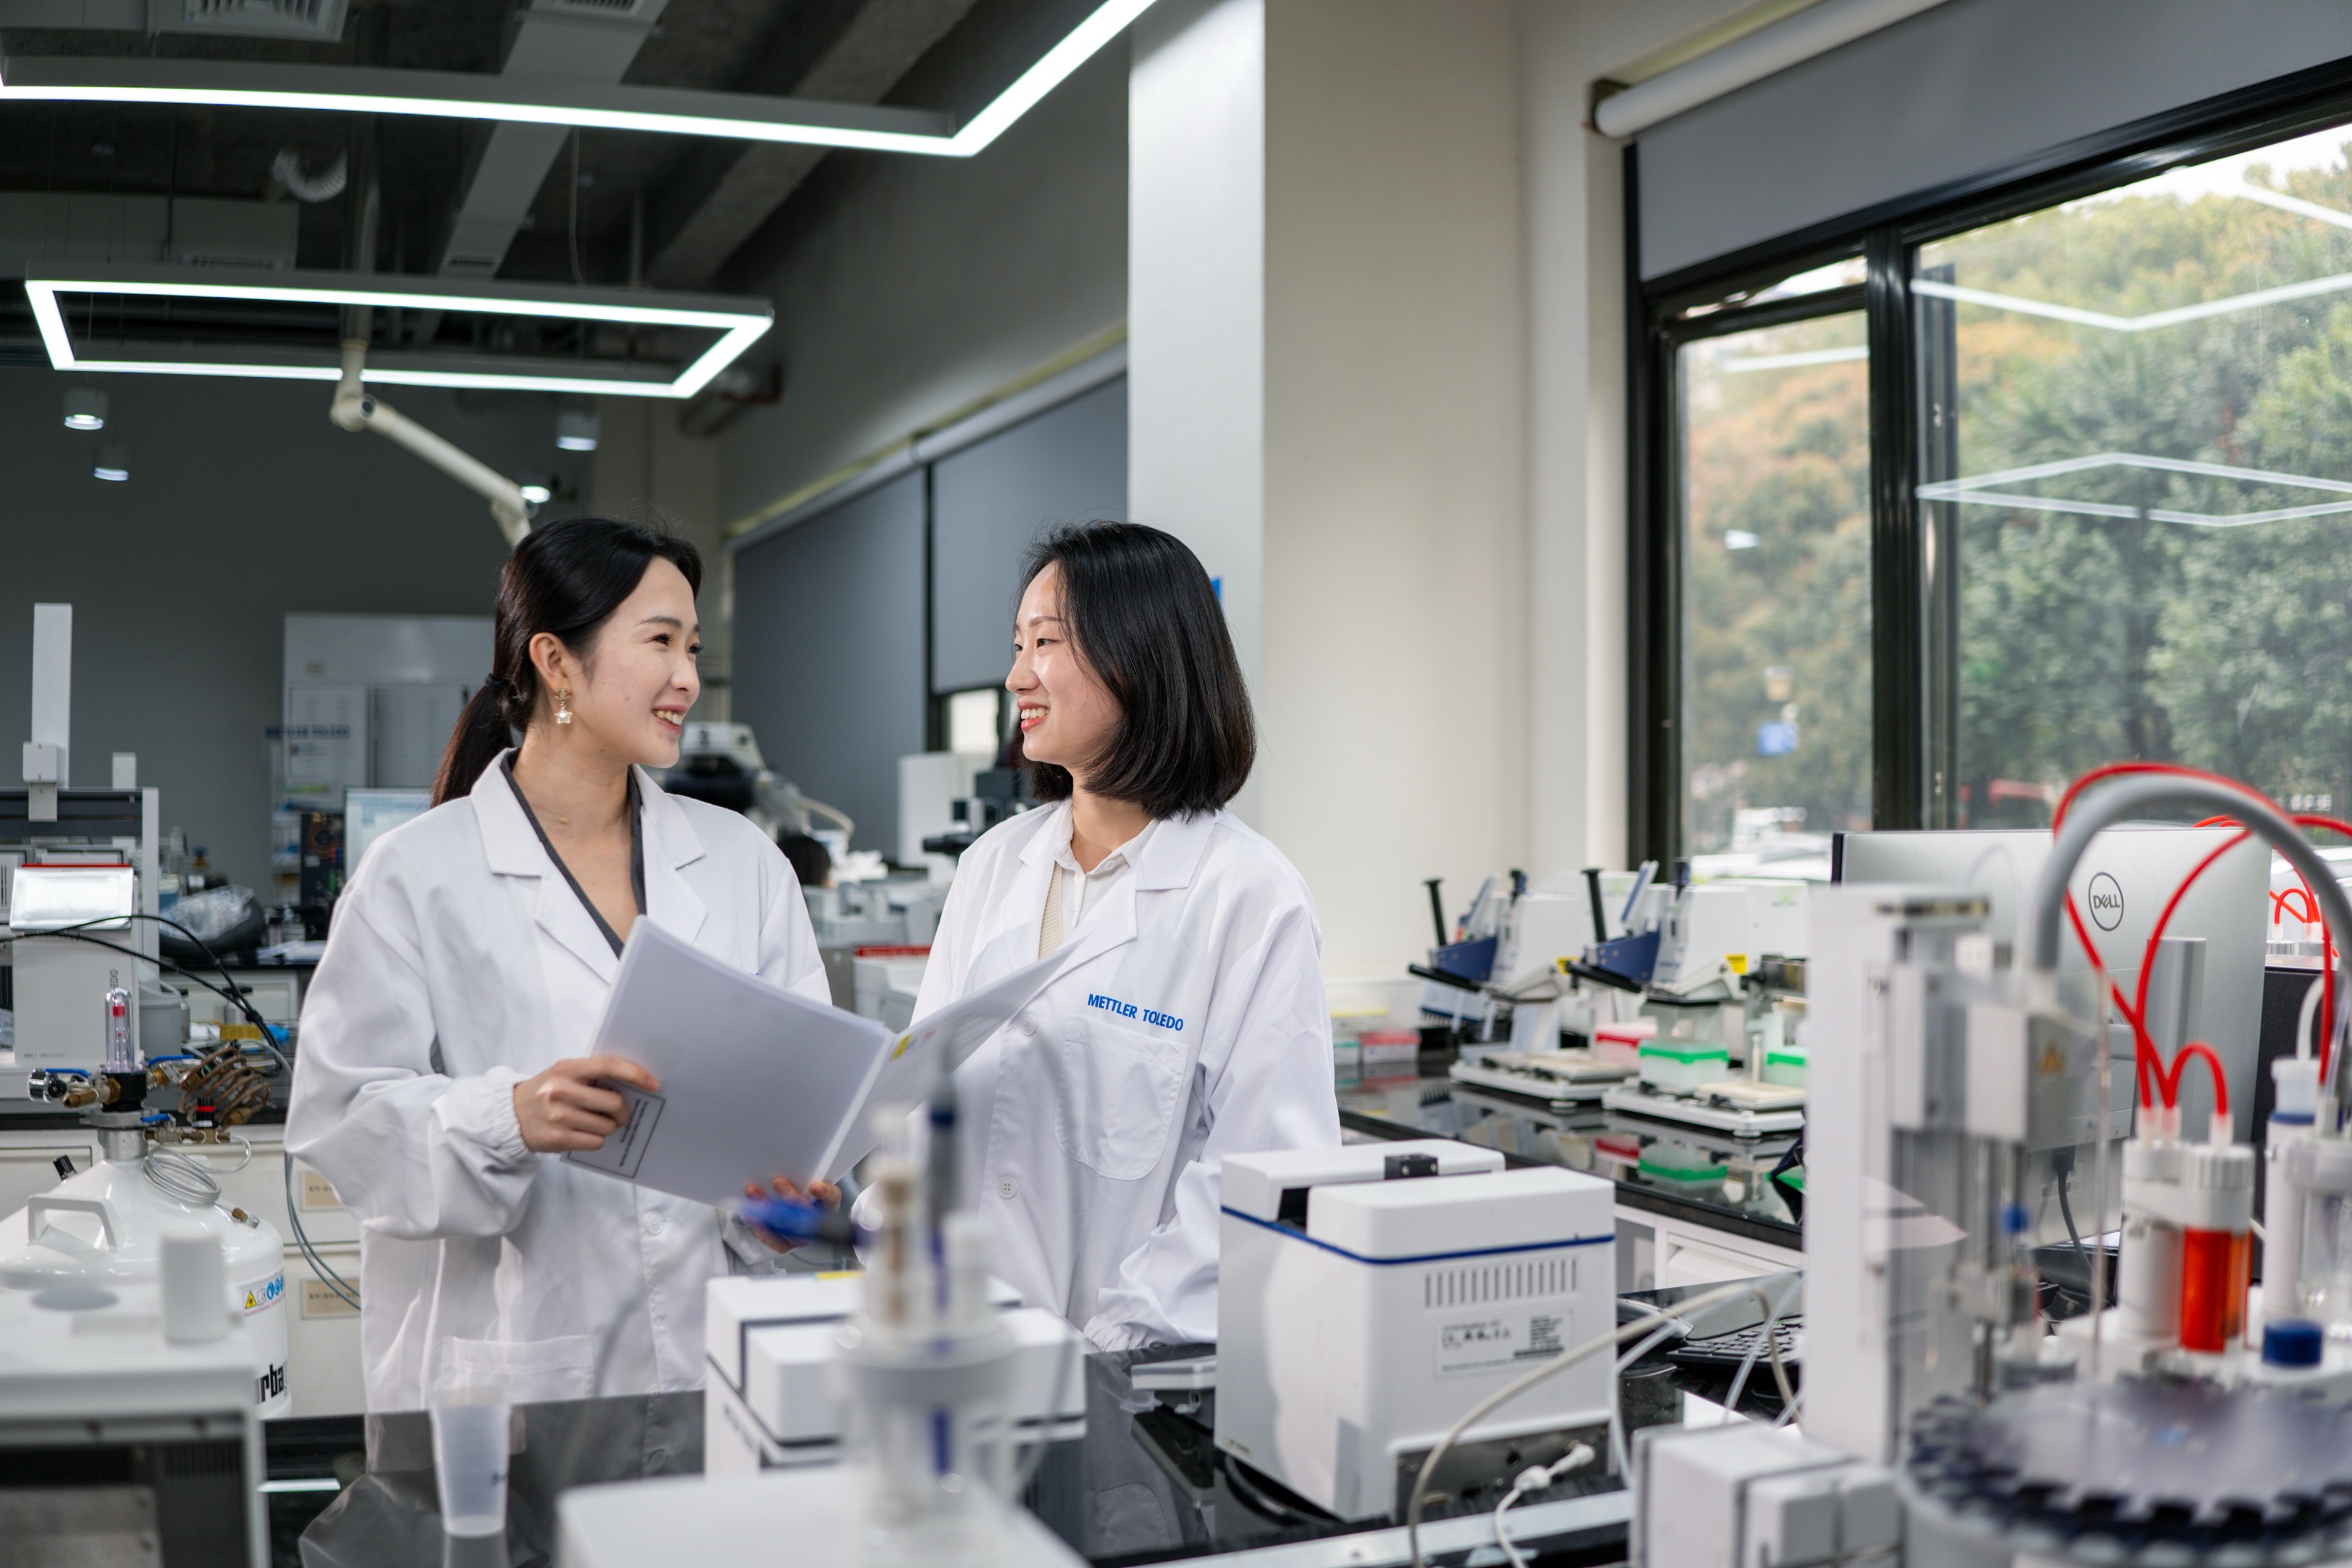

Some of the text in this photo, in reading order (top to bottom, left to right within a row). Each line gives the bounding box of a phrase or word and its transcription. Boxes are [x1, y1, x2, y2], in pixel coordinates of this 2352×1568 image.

[2093, 894, 2121, 909] DELL
[1087, 993, 1184, 1031] METTLER TOLEDO
